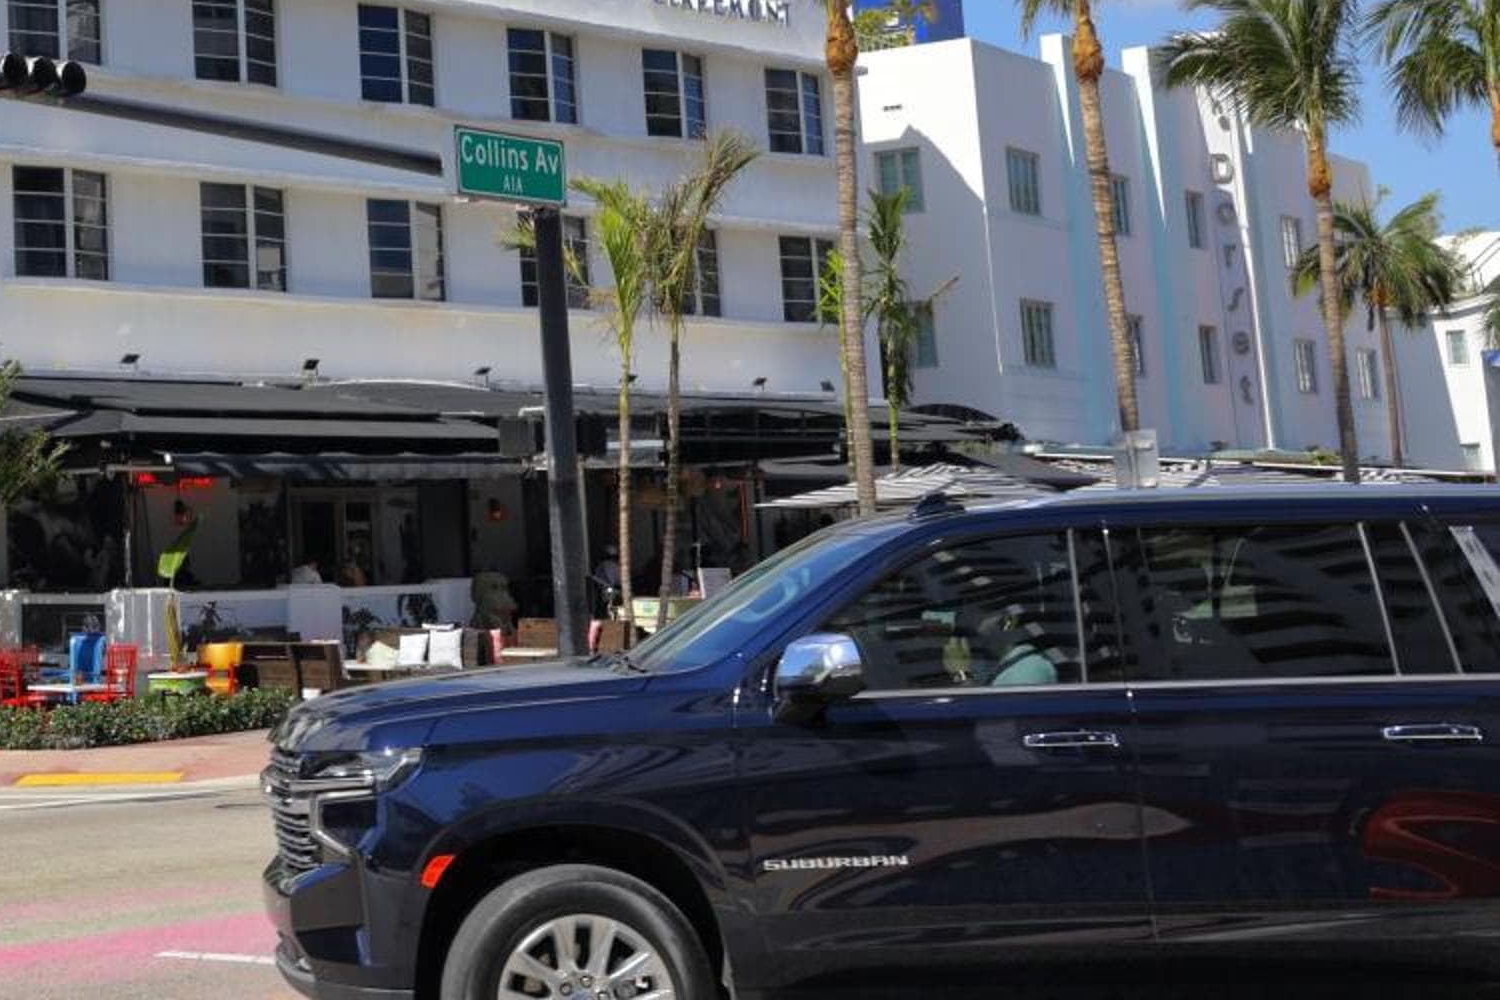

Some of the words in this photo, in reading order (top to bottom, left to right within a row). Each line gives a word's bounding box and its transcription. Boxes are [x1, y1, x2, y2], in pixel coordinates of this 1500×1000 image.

[461, 135, 528, 171] Collins
[535, 146, 559, 175] Av
[763, 855, 909, 871] SUBURBAN
